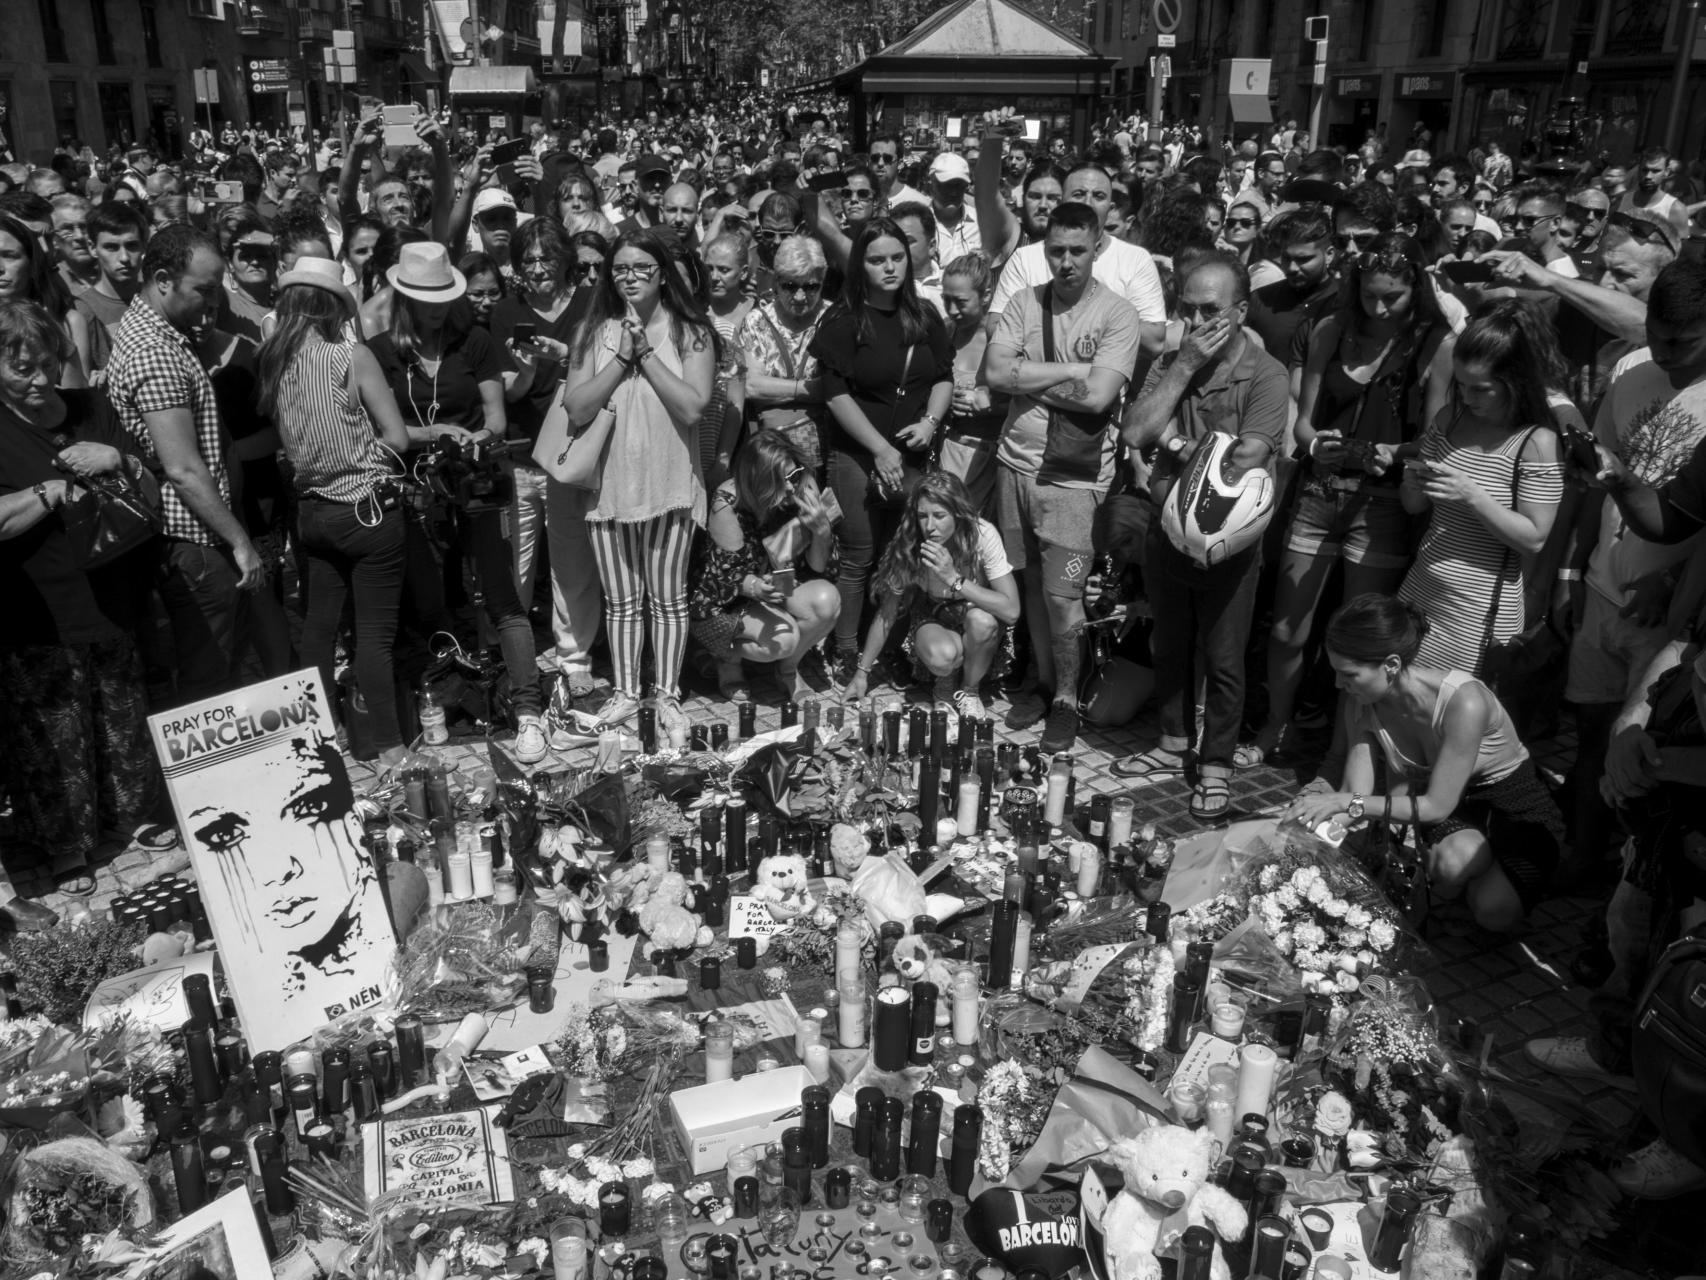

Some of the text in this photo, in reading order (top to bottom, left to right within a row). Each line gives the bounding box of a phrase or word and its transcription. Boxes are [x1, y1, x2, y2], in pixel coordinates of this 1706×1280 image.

[1409, 77, 1430, 95] pans
[1081, 342, 1093, 354] JB
[162, 705, 236, 738] PRAY FOR
[166, 699, 320, 762] BARCELONA
[755, 926, 776, 935] ITALY
[349, 984, 382, 1010] NÉN
[388, 1123, 478, 1148] BARCELONA
[415, 1151, 455, 1166] Edition
[411, 1167, 465, 1182] CAPITAL
[394, 1180, 485, 1204] ATALONIA
[1008, 1190, 1032, 1226] I
